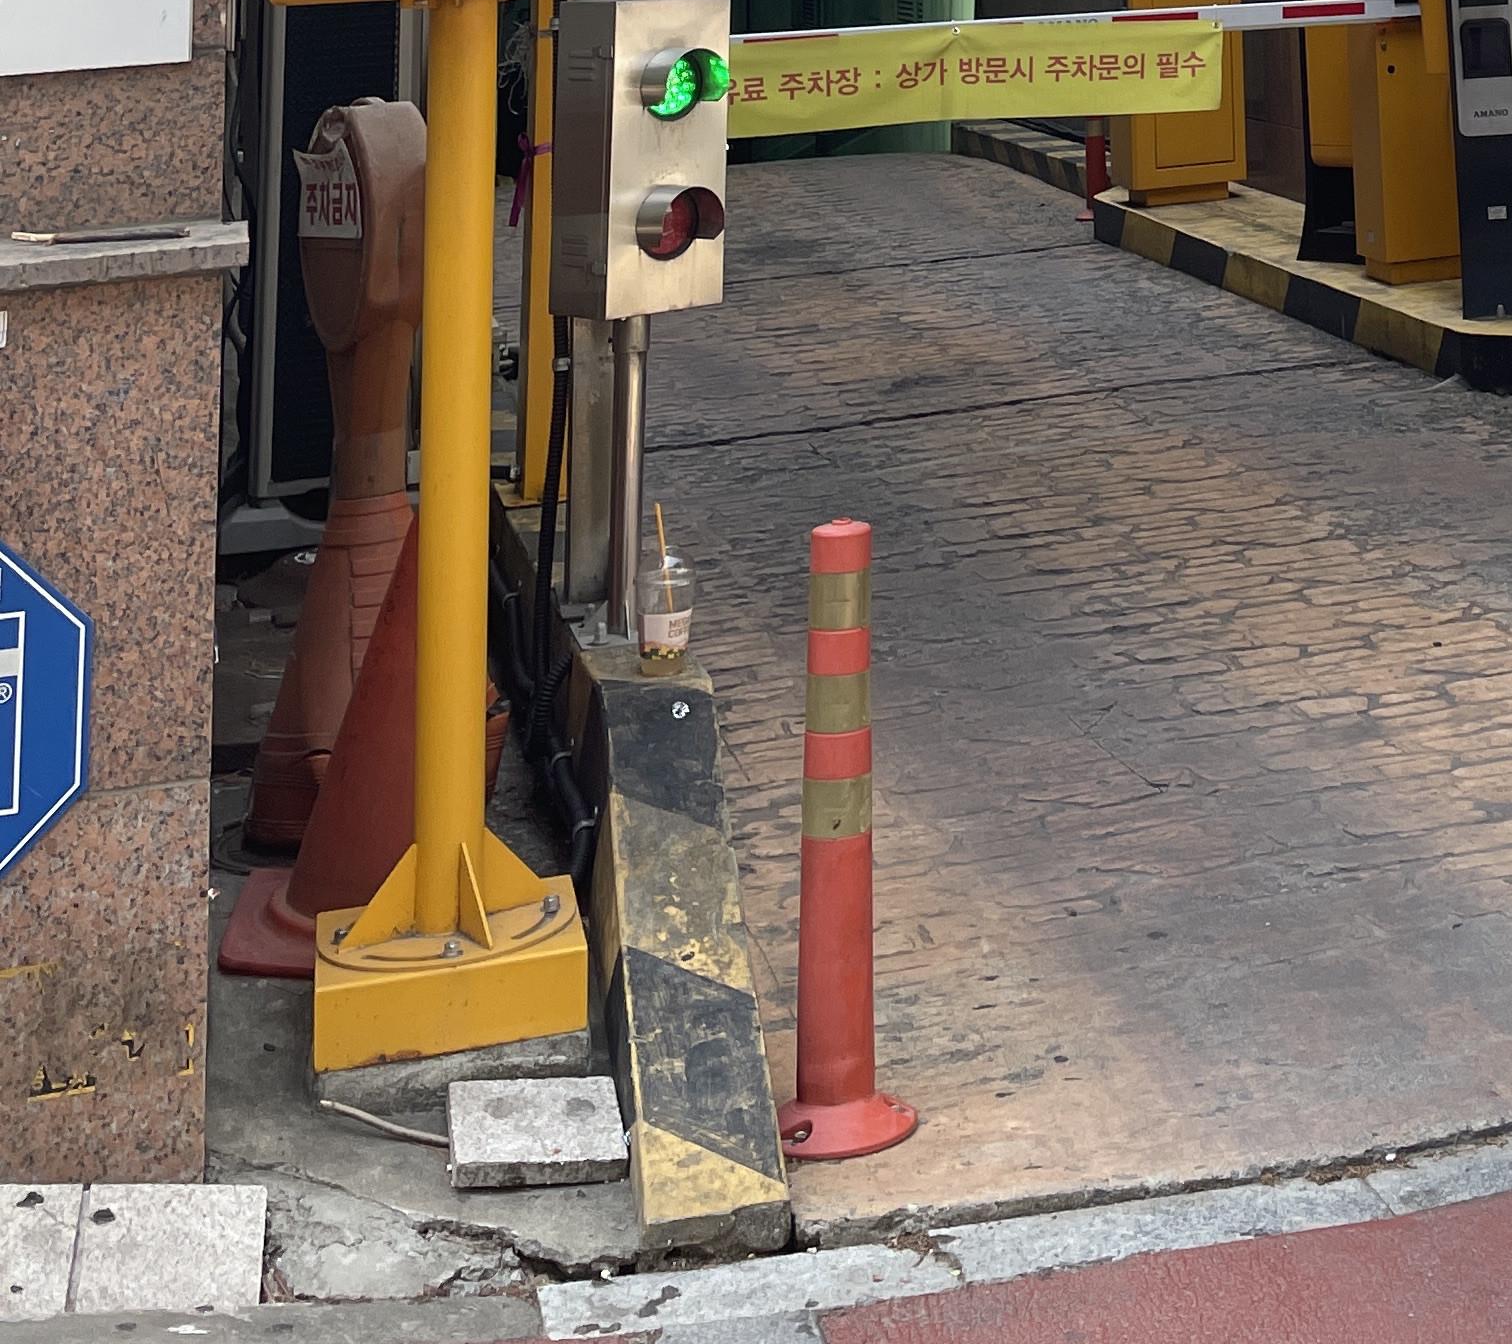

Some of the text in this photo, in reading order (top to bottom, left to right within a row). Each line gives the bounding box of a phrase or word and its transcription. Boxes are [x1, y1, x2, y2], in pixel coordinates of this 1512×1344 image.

[777, 66, 861, 100] 주차장
[895, 58, 948, 89] 상가
[958, 53, 1035, 85] 방문시
[1044, 50, 1147, 80] 주차문의
[1155, 49, 1207, 79] 필수
[305, 181, 358, 226] 주차금지
